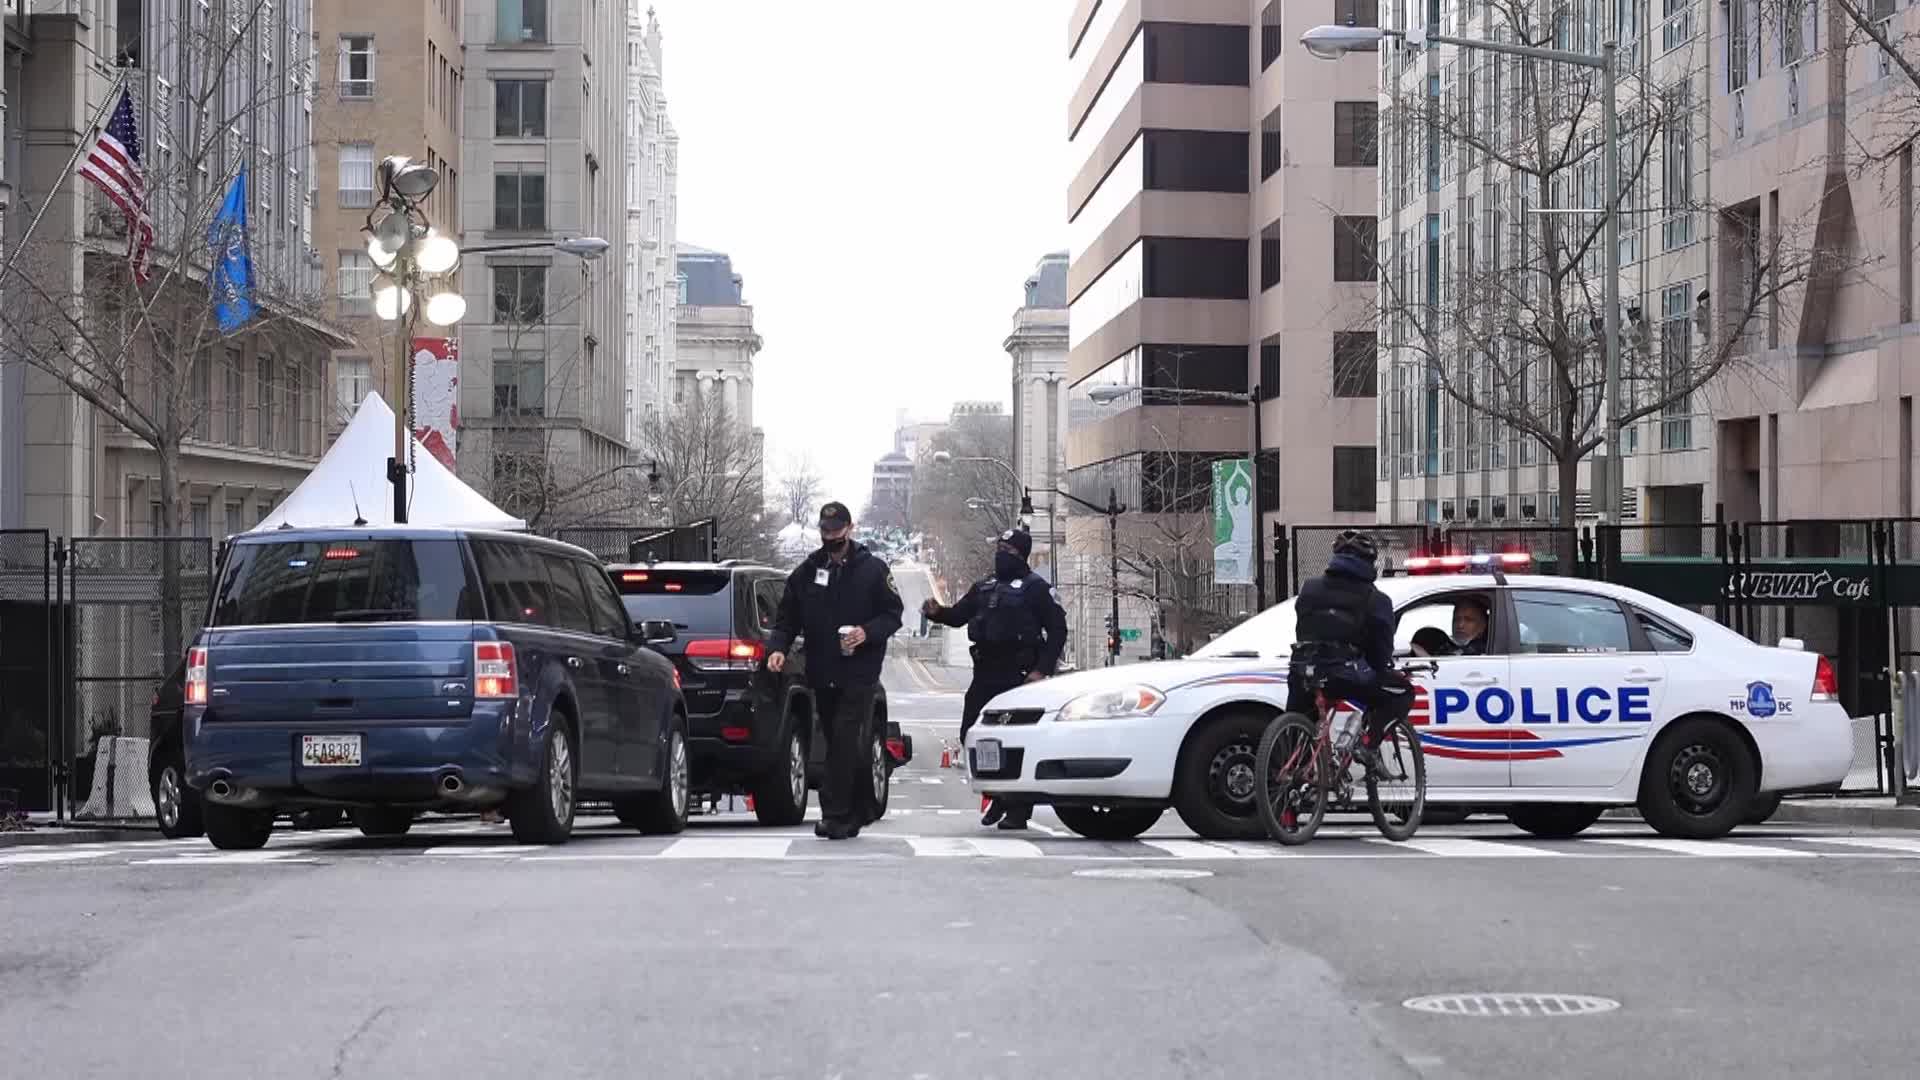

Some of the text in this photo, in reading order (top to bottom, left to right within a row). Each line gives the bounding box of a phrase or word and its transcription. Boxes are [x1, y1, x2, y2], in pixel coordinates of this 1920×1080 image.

[1434, 687, 1652, 724] POLICE
[1730, 700, 1745, 711] MP
[1778, 701, 1793, 712] DC
